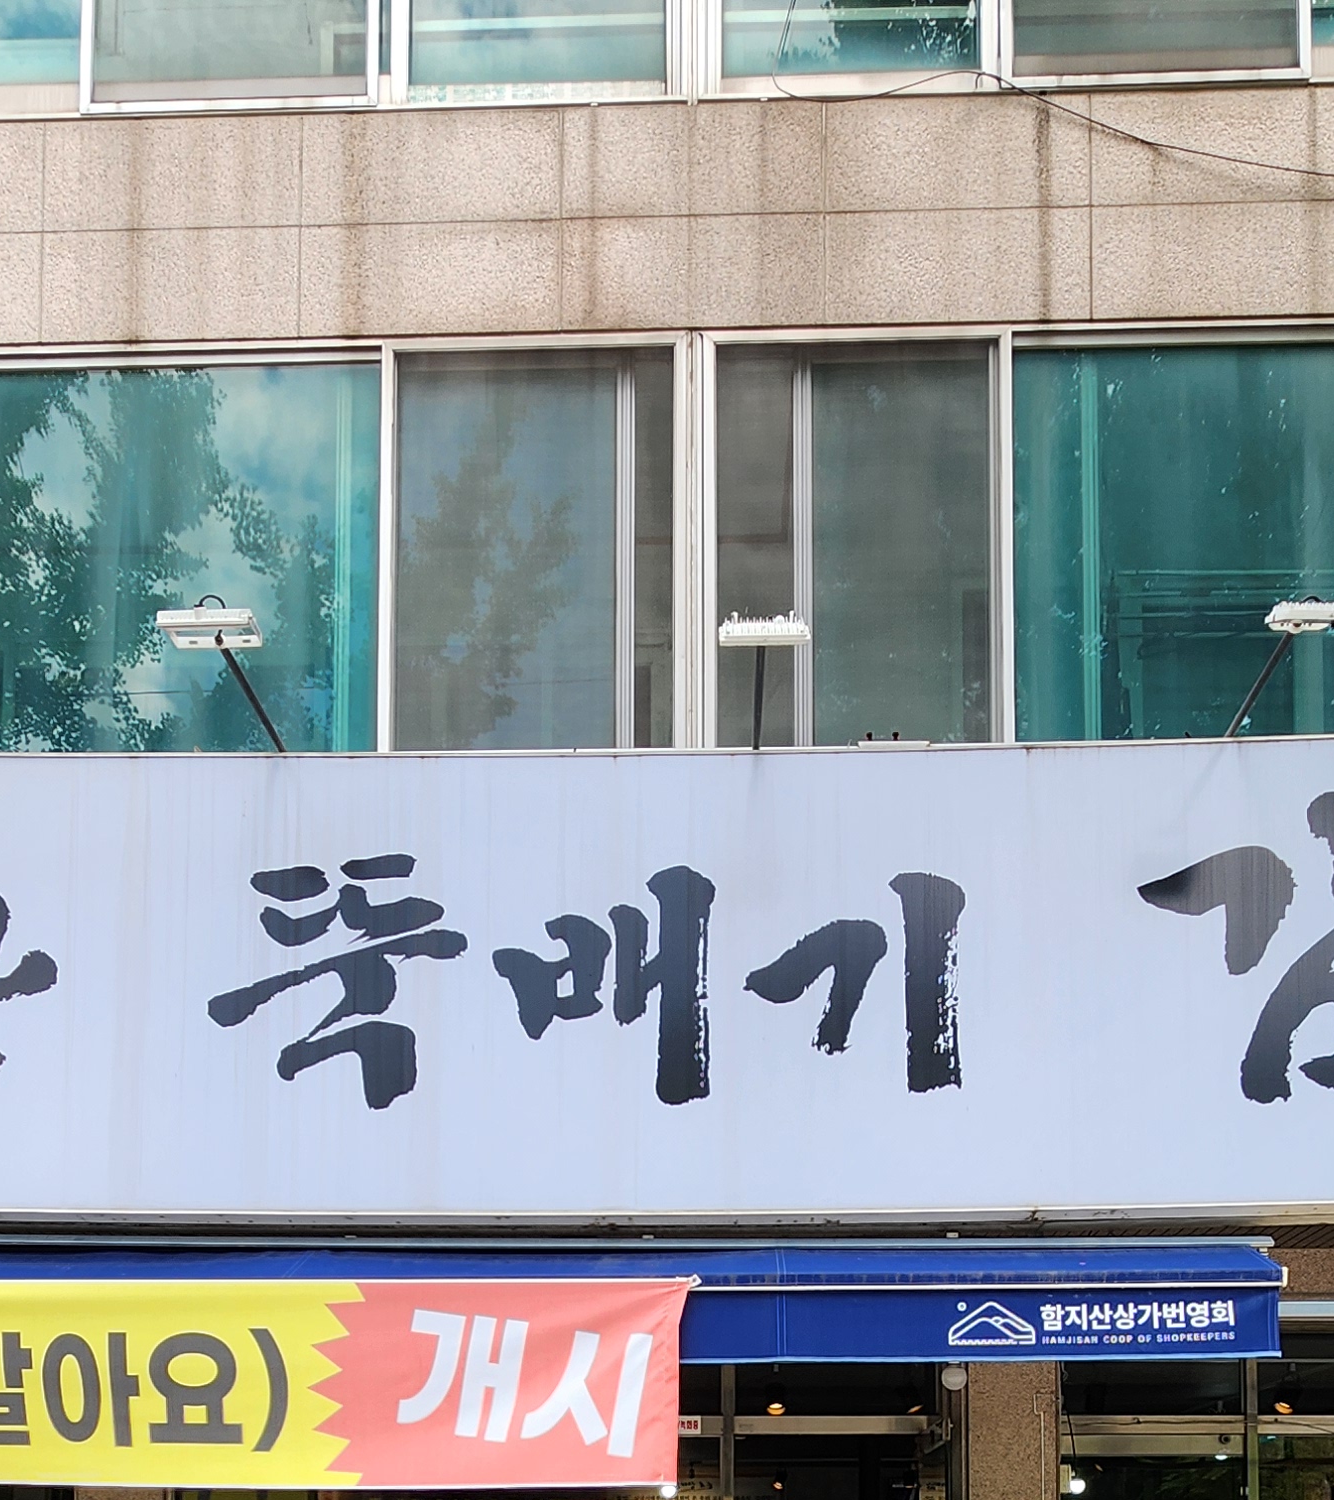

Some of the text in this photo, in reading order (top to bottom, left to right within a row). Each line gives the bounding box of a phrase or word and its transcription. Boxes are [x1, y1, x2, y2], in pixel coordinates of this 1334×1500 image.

[208, 854, 965, 1109] 뚝배기
[1040, 1300, 1235, 1331] 함지산상가번영회
[1103, 1334, 1133, 1344] COOP
[1137, 1333, 1153, 1343] OF
[1156, 1331, 1235, 1343] SHOPKEEPERS
[398, 1310, 653, 1457] 개시
